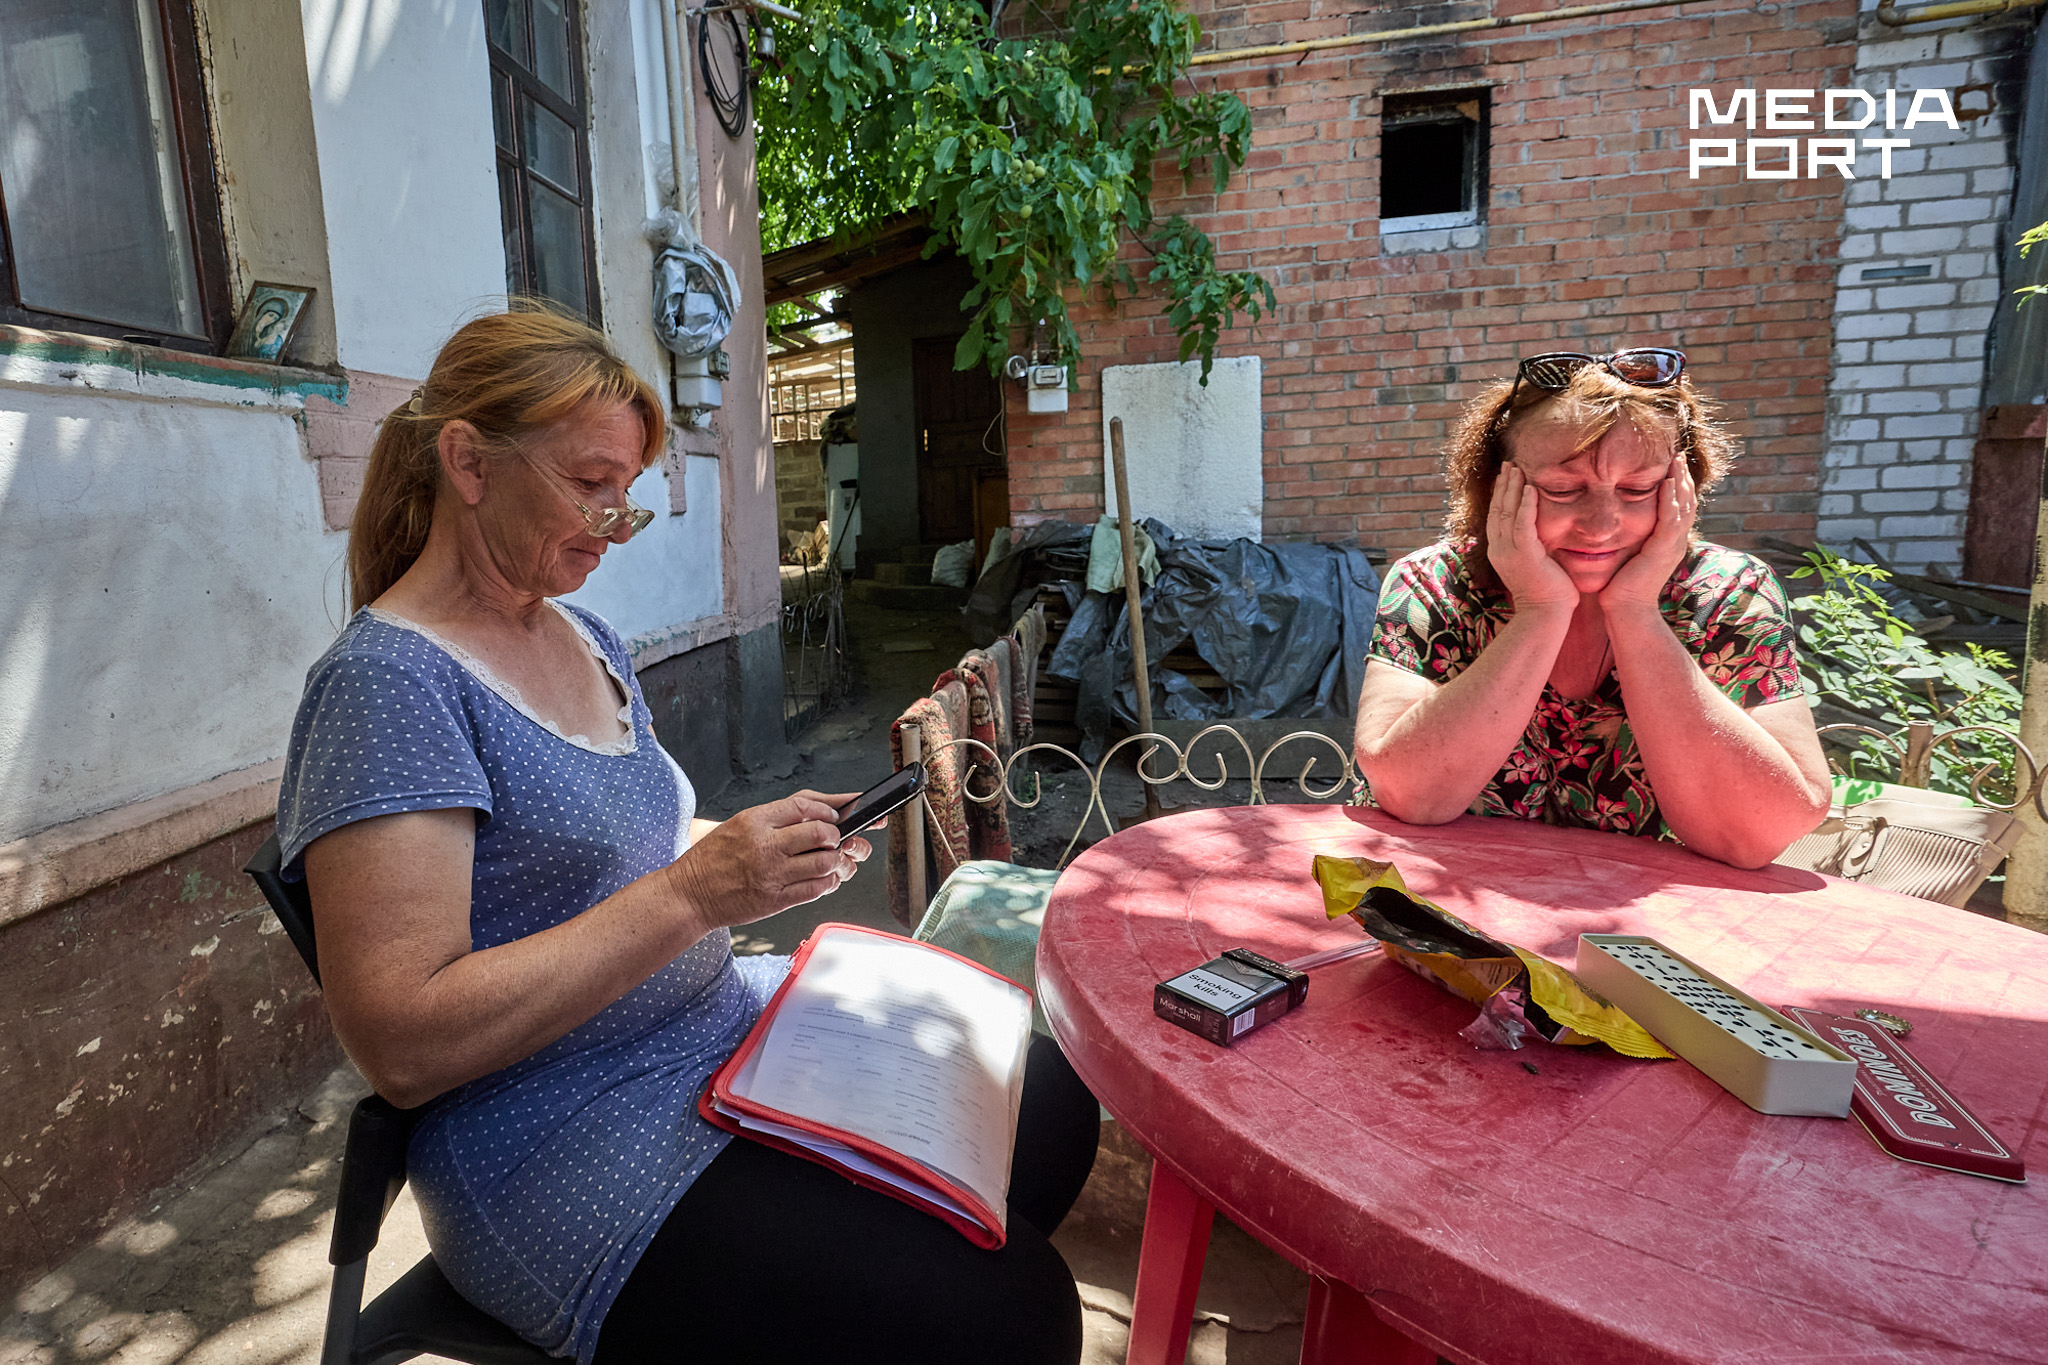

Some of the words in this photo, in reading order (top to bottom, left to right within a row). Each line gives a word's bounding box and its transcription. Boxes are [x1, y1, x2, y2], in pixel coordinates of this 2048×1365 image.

[1188, 974, 1242, 1000] Smoking
[1193, 983, 1219, 997] kills
[1159, 996, 1201, 1022] Marshall
[1830, 1026, 1957, 1130] DOMINOES
